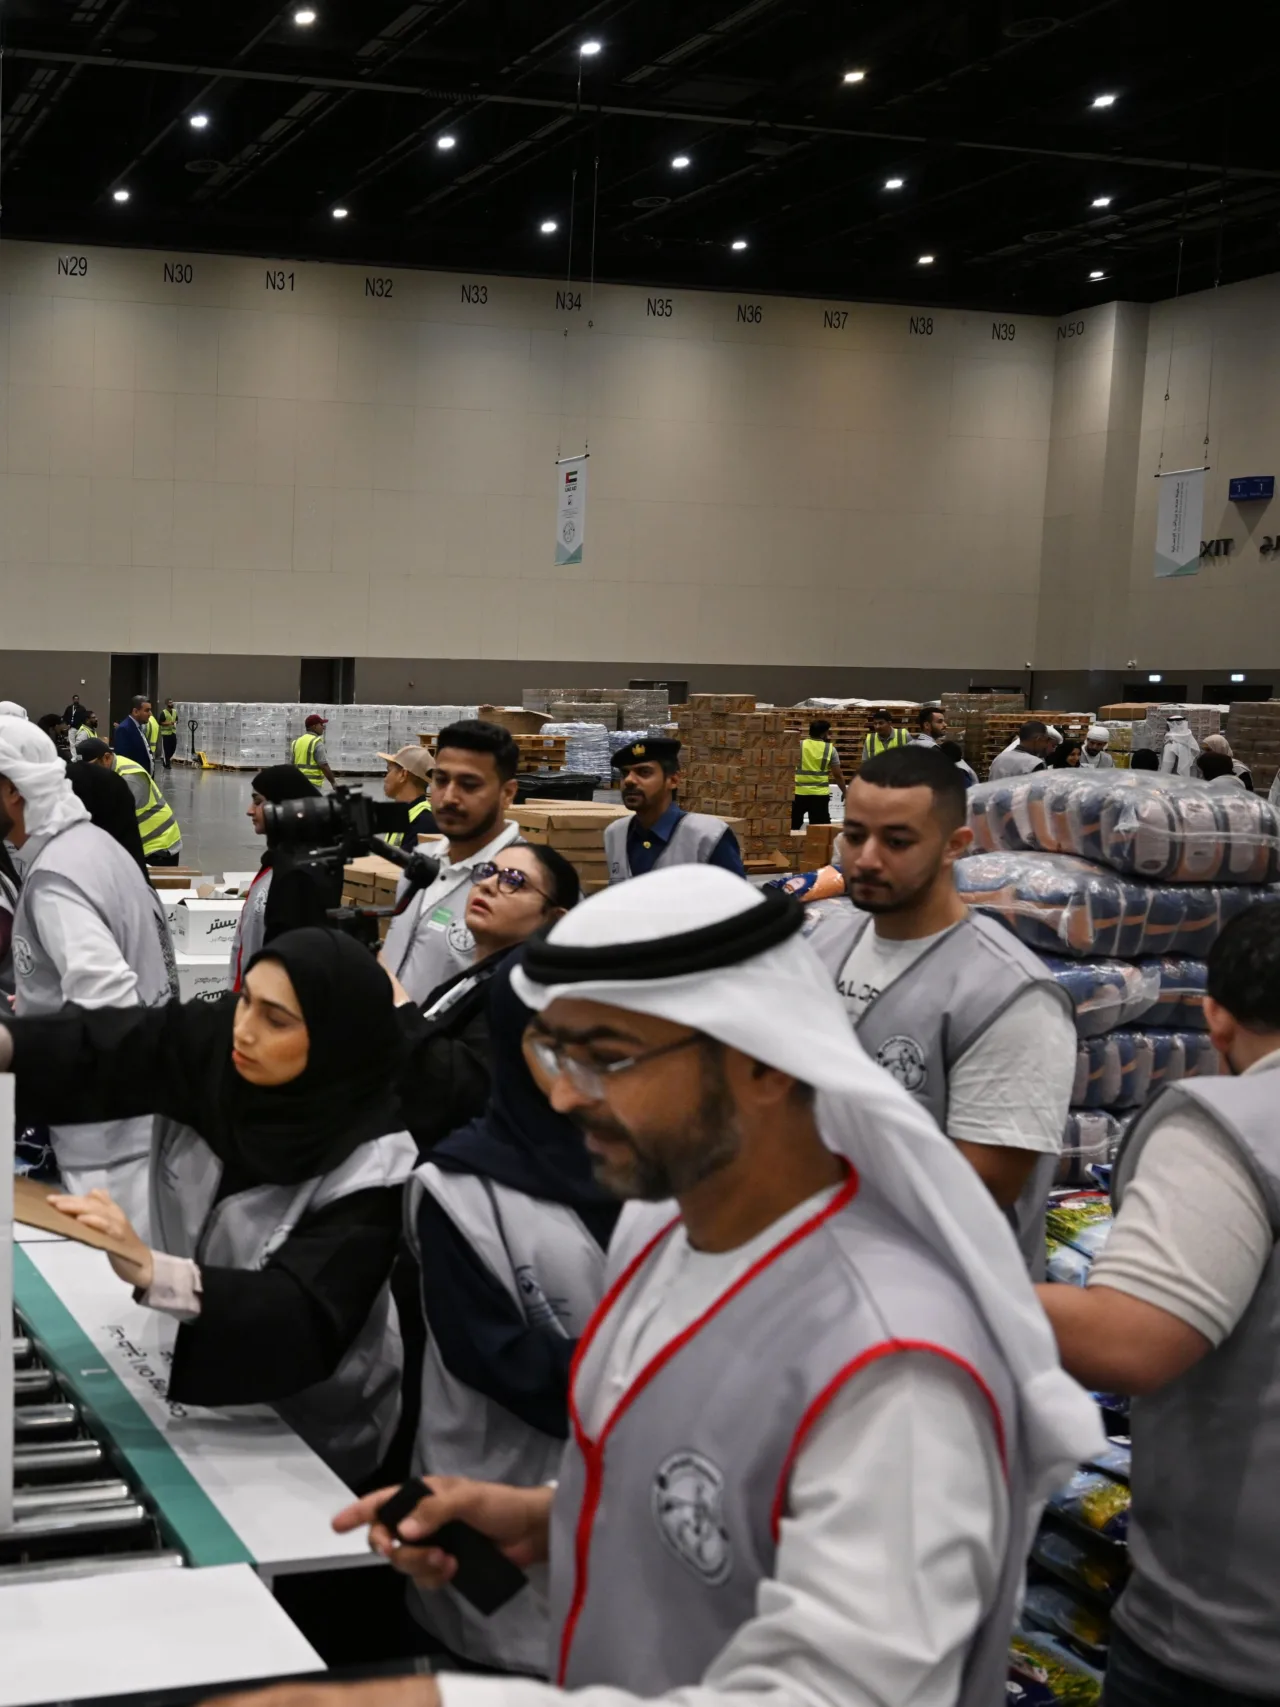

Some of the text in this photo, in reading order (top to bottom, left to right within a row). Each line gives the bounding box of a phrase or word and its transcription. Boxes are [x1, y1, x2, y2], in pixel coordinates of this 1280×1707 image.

[57, 256, 88, 277] N29
[163, 263, 194, 284] N30
[265, 270, 295, 291] N31
[365, 277, 393, 298] N32
[461, 284, 488, 305] N33
[555, 291, 582, 312] N34
[646, 298, 673, 318] N35
[736, 303, 762, 324] N36
[823, 310, 848, 330] N37
[908, 316, 934, 336] N38
[1056, 320, 1085, 341] N50
[991, 322, 1016, 342] N39
[1200, 538, 1234, 558] XIT
